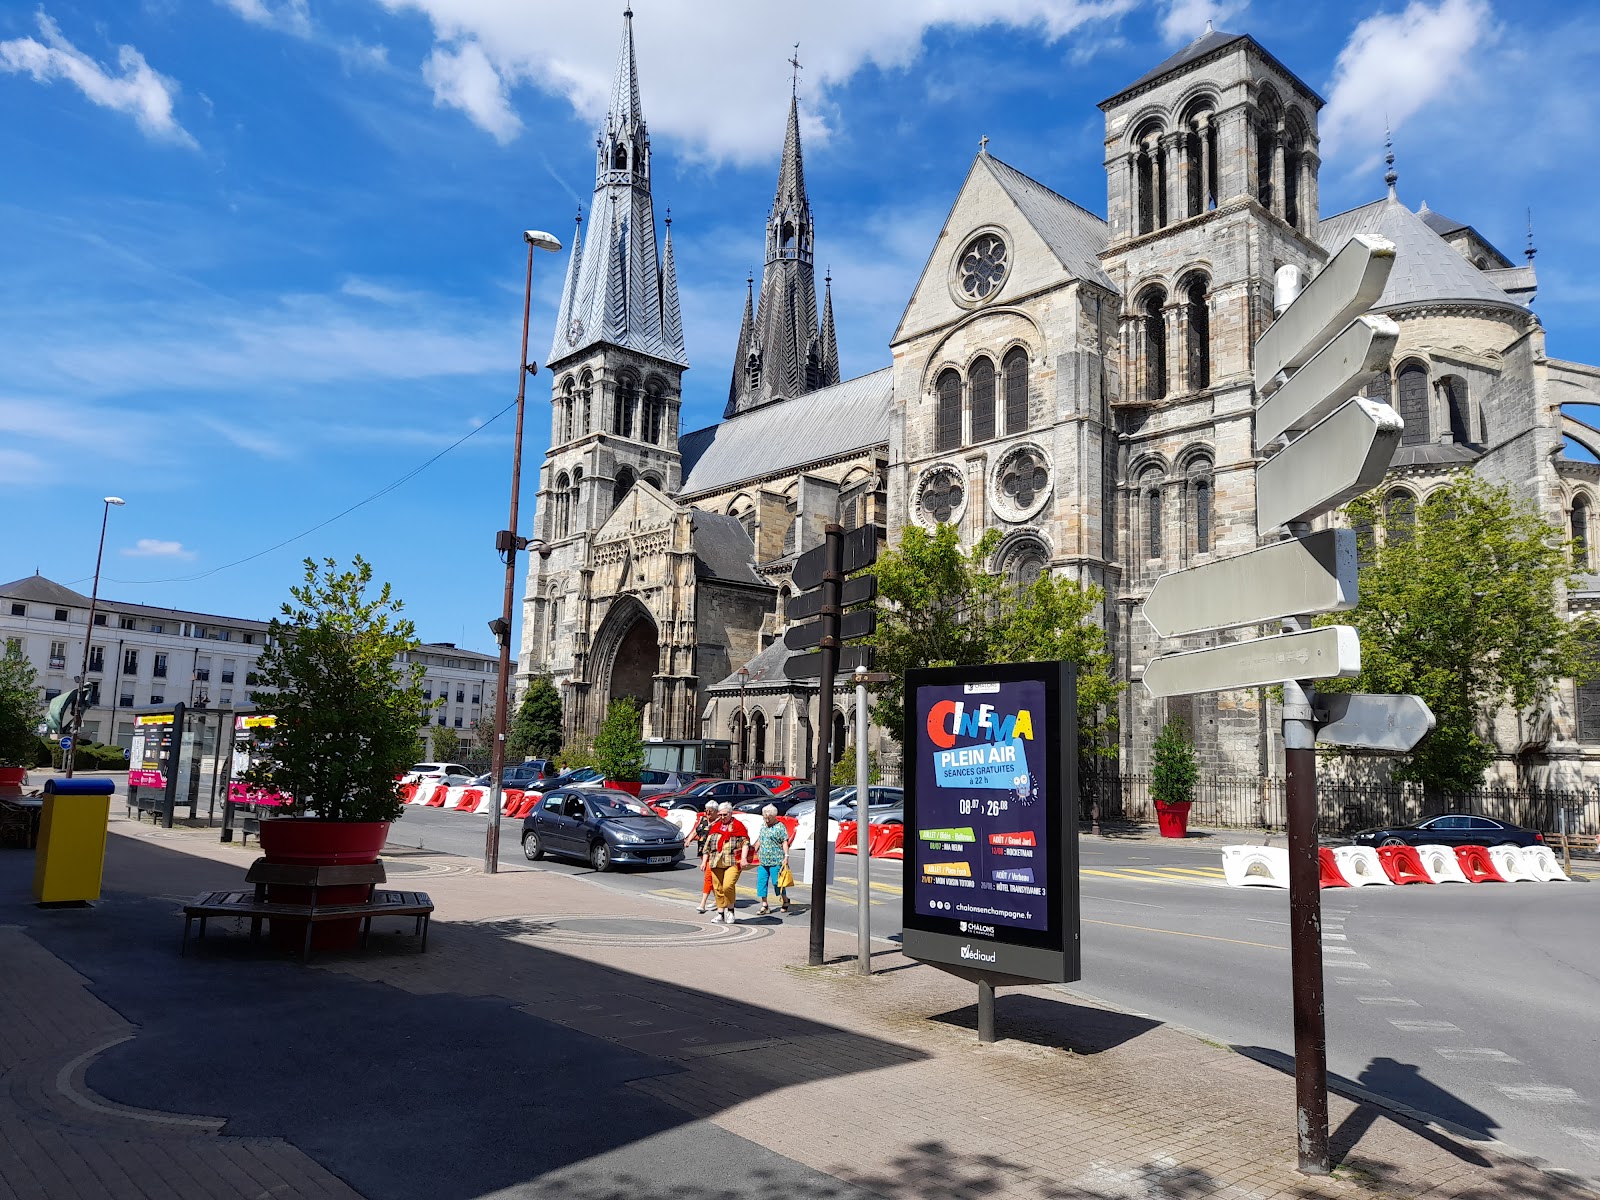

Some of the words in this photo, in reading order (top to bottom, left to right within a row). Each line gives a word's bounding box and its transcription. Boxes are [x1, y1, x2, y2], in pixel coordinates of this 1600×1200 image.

[941, 749, 985, 768] PLEIN
[988, 746, 1016, 764] AIR
[976, 764, 1015, 775] GRATUITES
[975, 776, 983, 785] 22
[984, 775, 989, 784] h
[1006, 848, 1033, 858] ROCKETMAN
[959, 879, 975, 889] TOTORO
[996, 882, 1009, 892] HÔTEL
[1009, 884, 1041, 896] TRANSYLVANIE
[1041, 887, 1046, 896] 3
[956, 902, 1032, 920] chalonsenchampagne.fr
